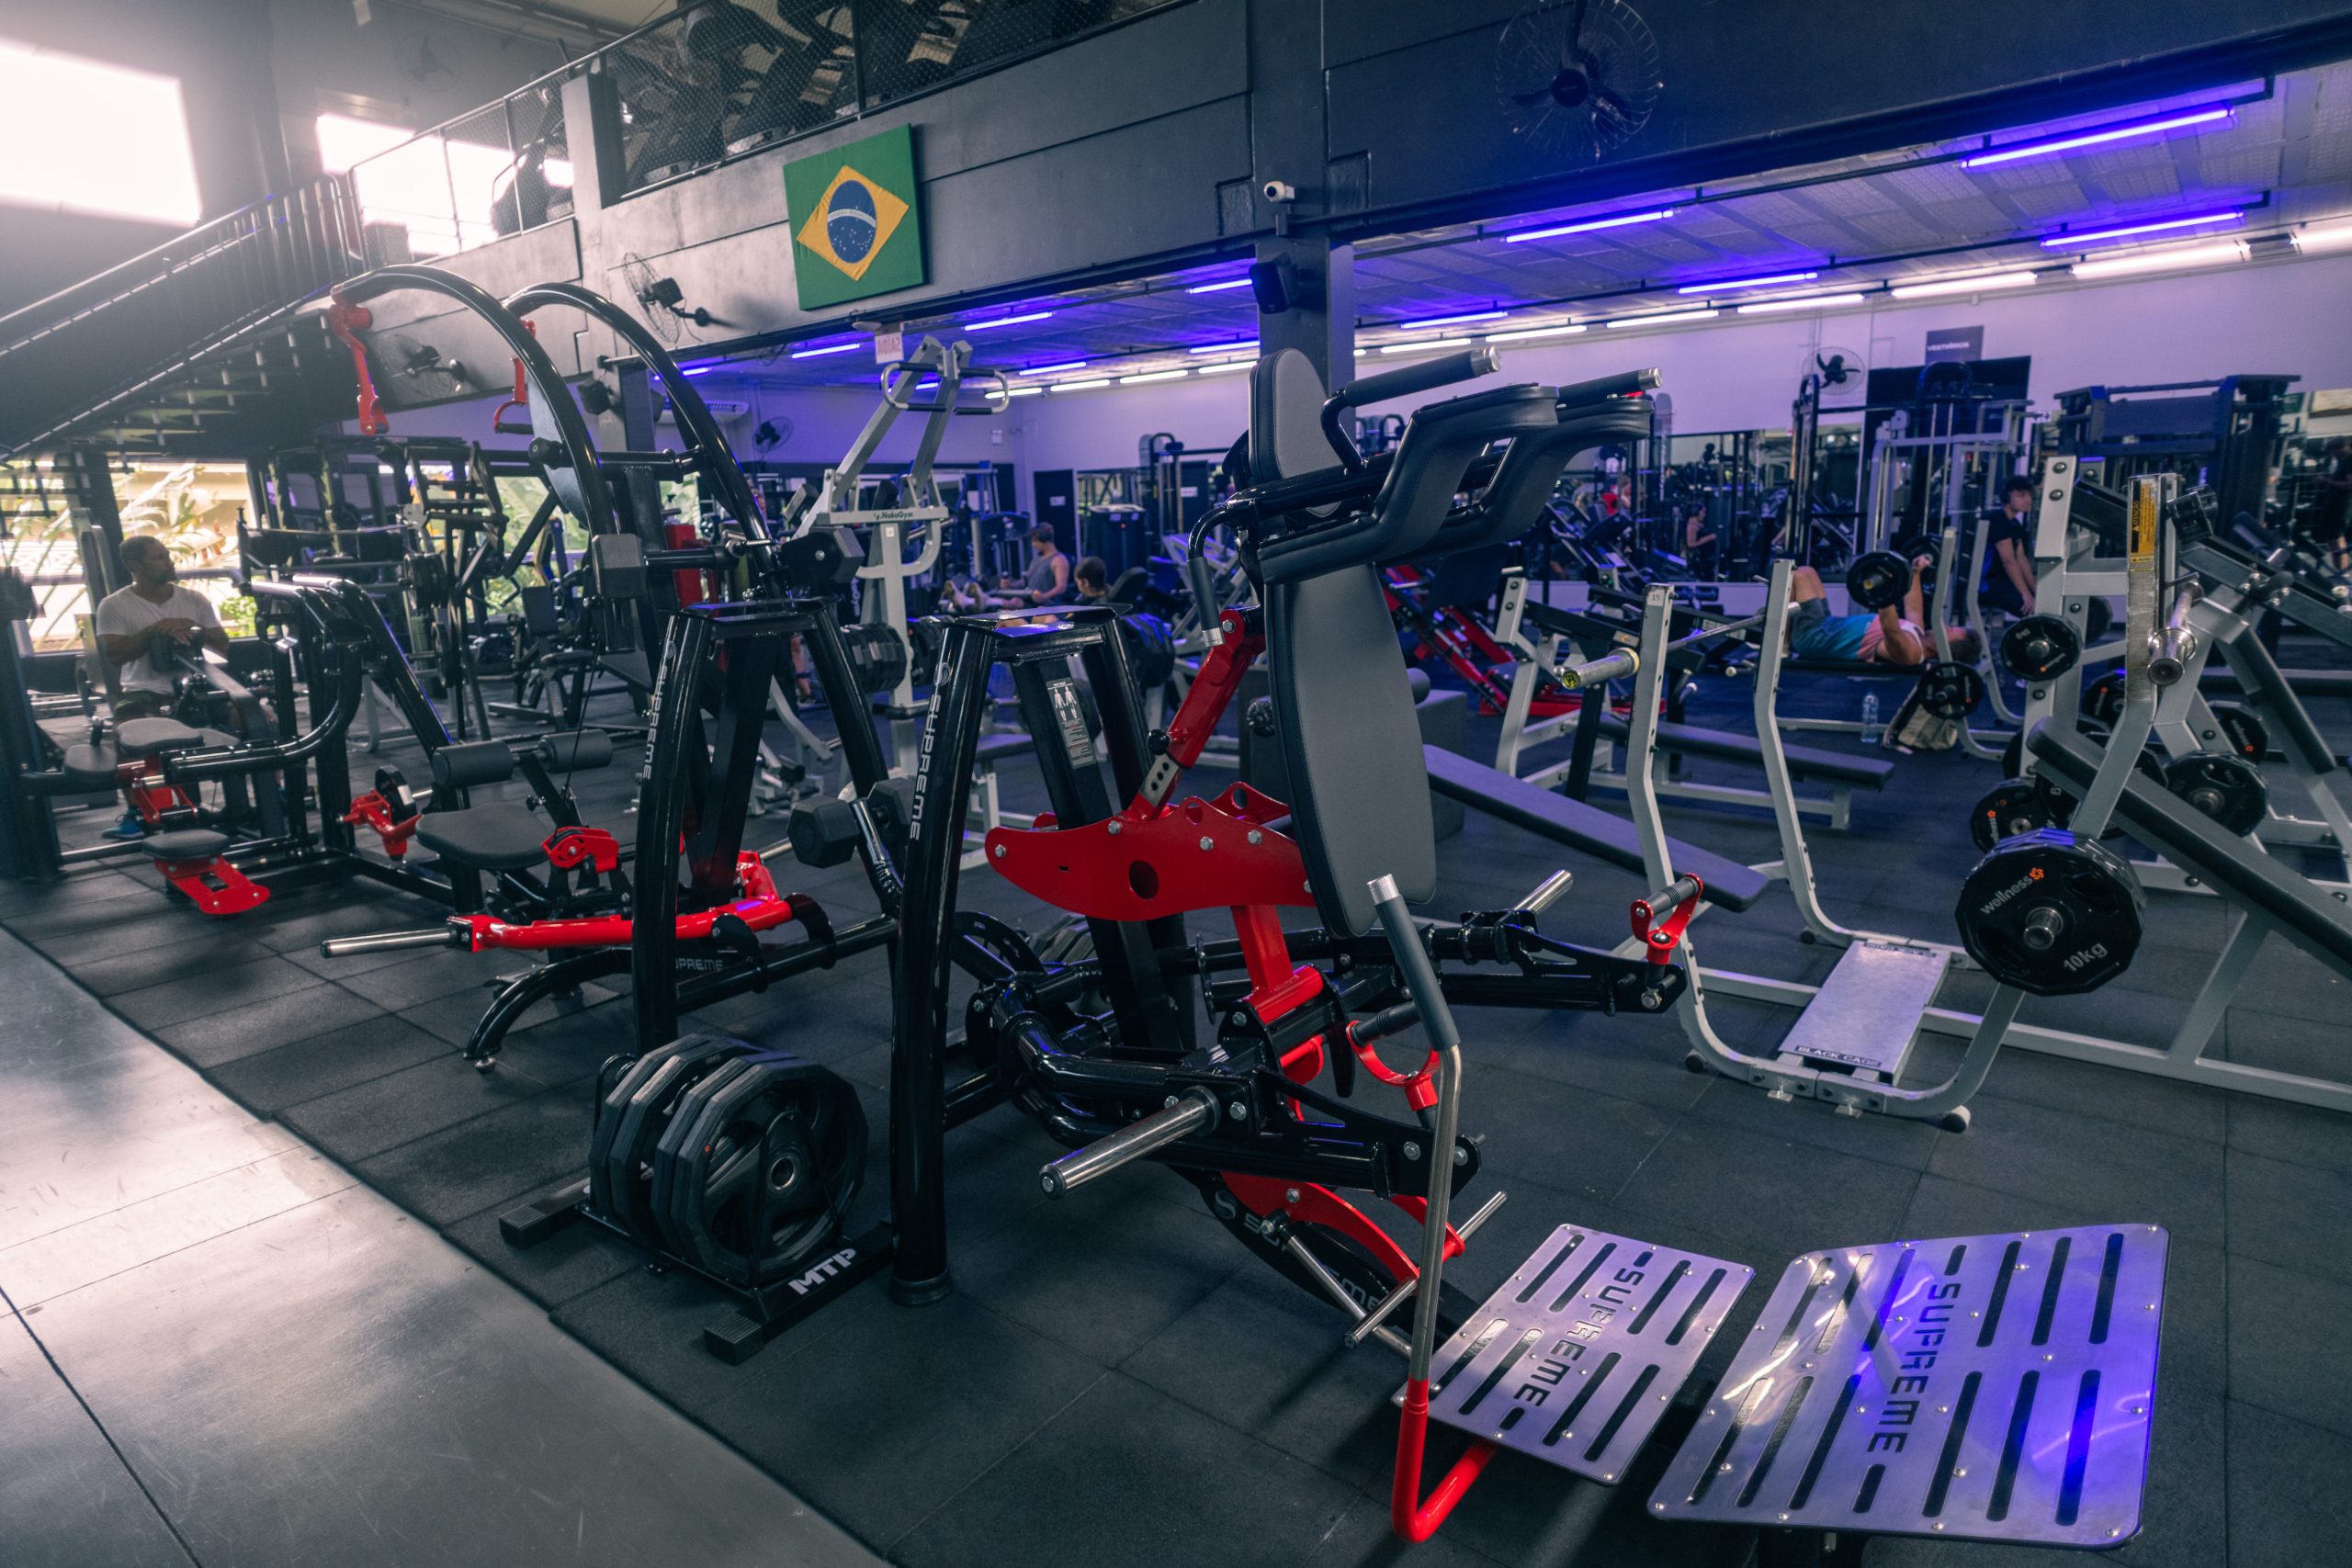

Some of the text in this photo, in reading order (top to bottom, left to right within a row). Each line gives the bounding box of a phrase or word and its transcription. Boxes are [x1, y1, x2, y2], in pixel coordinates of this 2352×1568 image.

[643, 664, 668, 780] SUPREME
[910, 694, 942, 840] SUPREME
[1980, 874, 2034, 915] wellness
[2063, 942, 2109, 972] 10kg
[1798, 1046, 1838, 1058] BLACK
[787, 1248, 856, 1295] MTP
[1513, 1268, 1645, 1406] SUPREME
[1867, 1283, 1962, 1452] SUPREME
